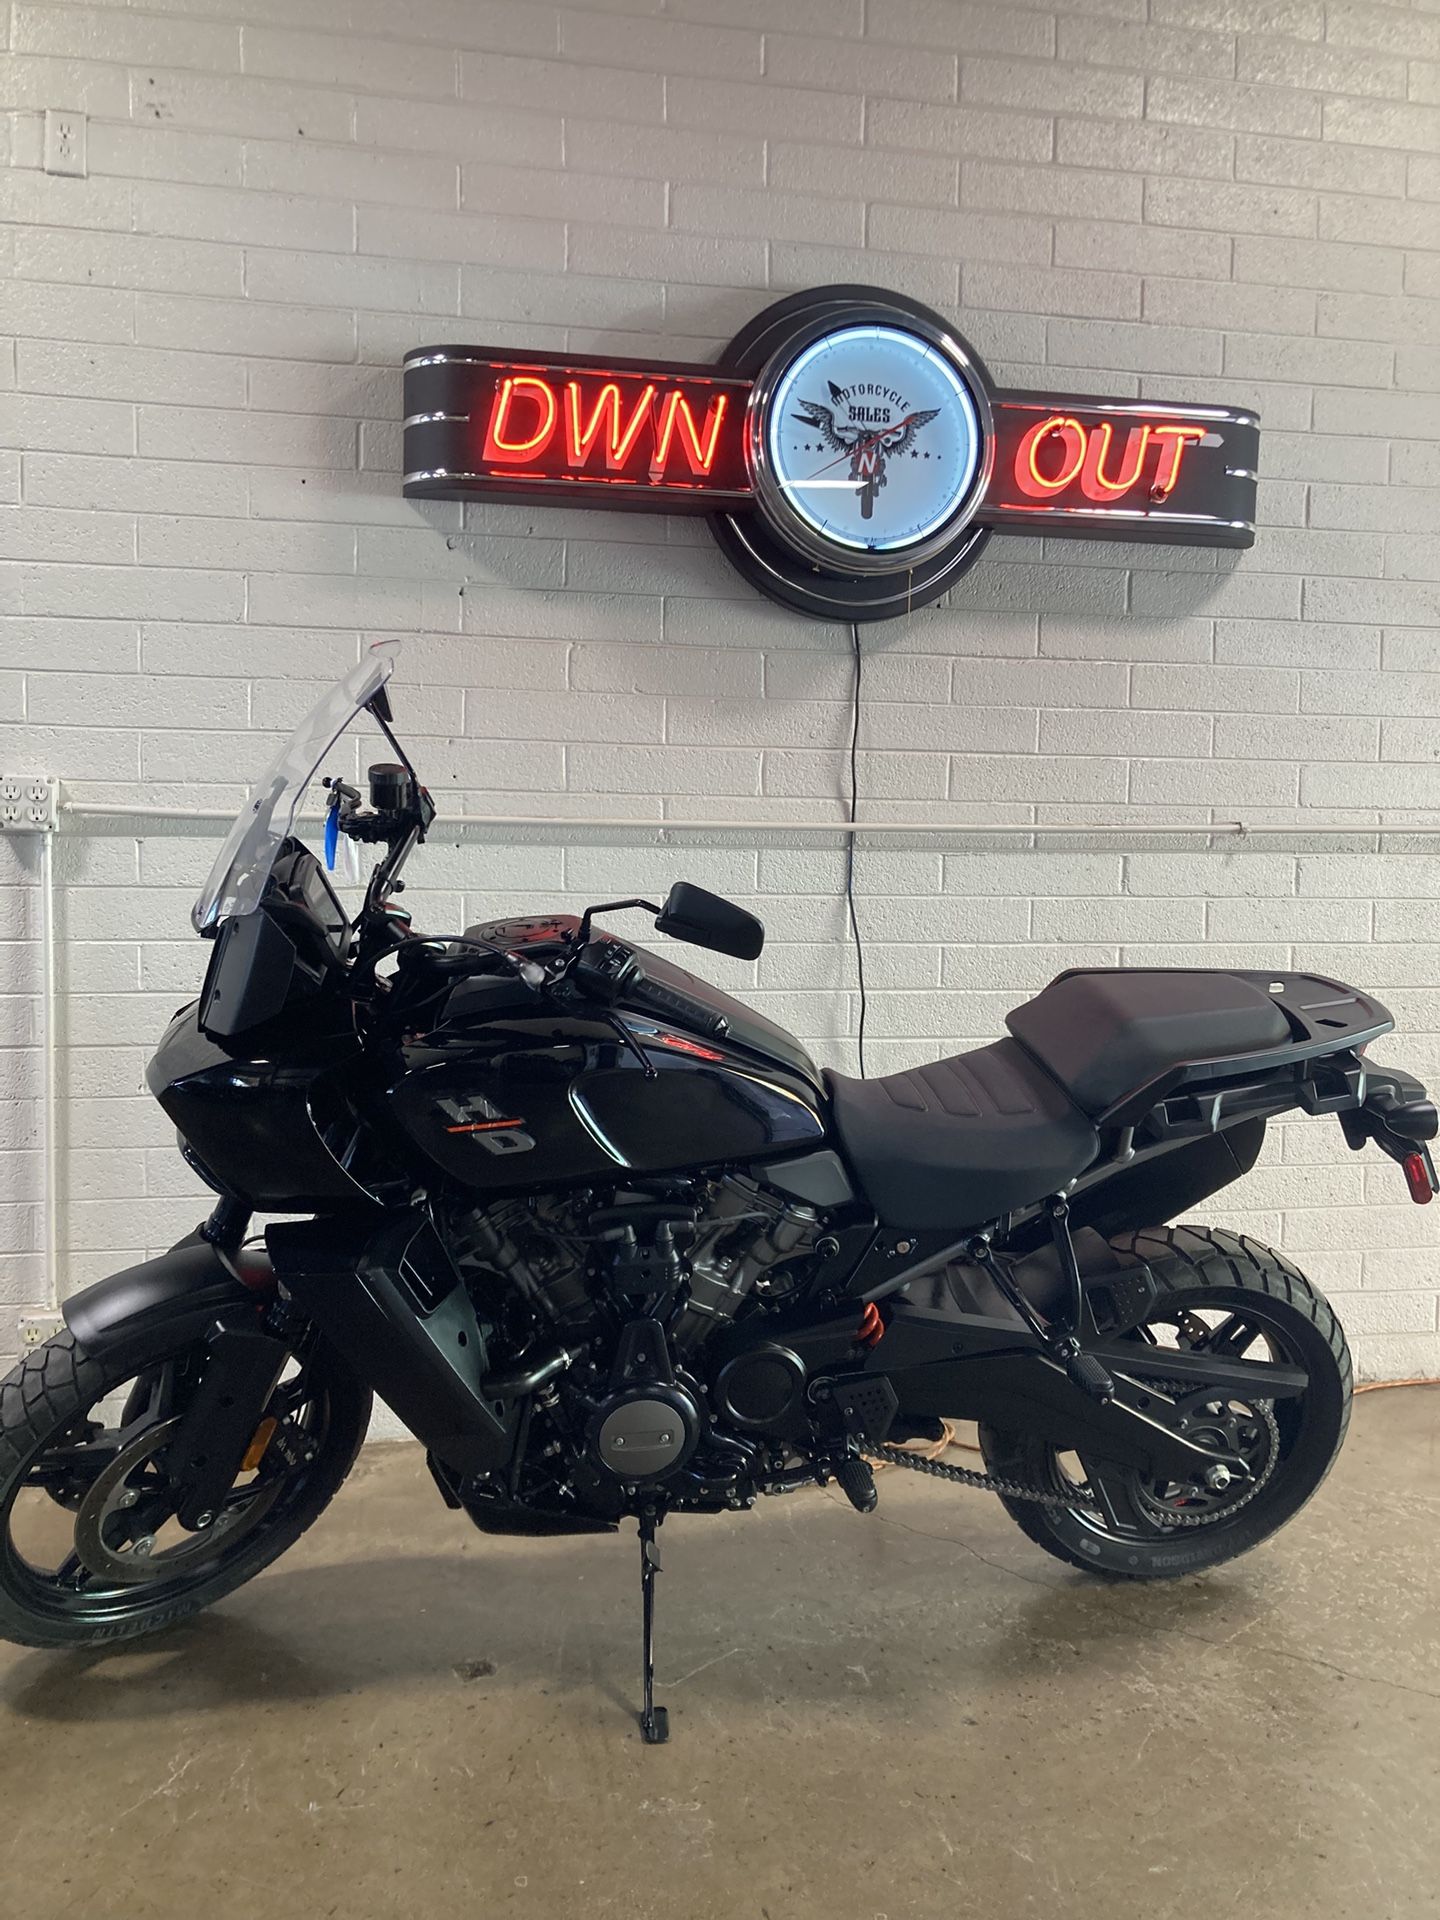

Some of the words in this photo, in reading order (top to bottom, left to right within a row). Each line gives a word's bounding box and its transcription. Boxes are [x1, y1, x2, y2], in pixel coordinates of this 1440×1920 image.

[831, 383, 911, 413] MOTORCYCLE
[482, 377, 728, 481] DWN
[848, 405, 891, 423] SALES
[858, 453, 876, 474] N
[1014, 416, 1224, 502] OUT
